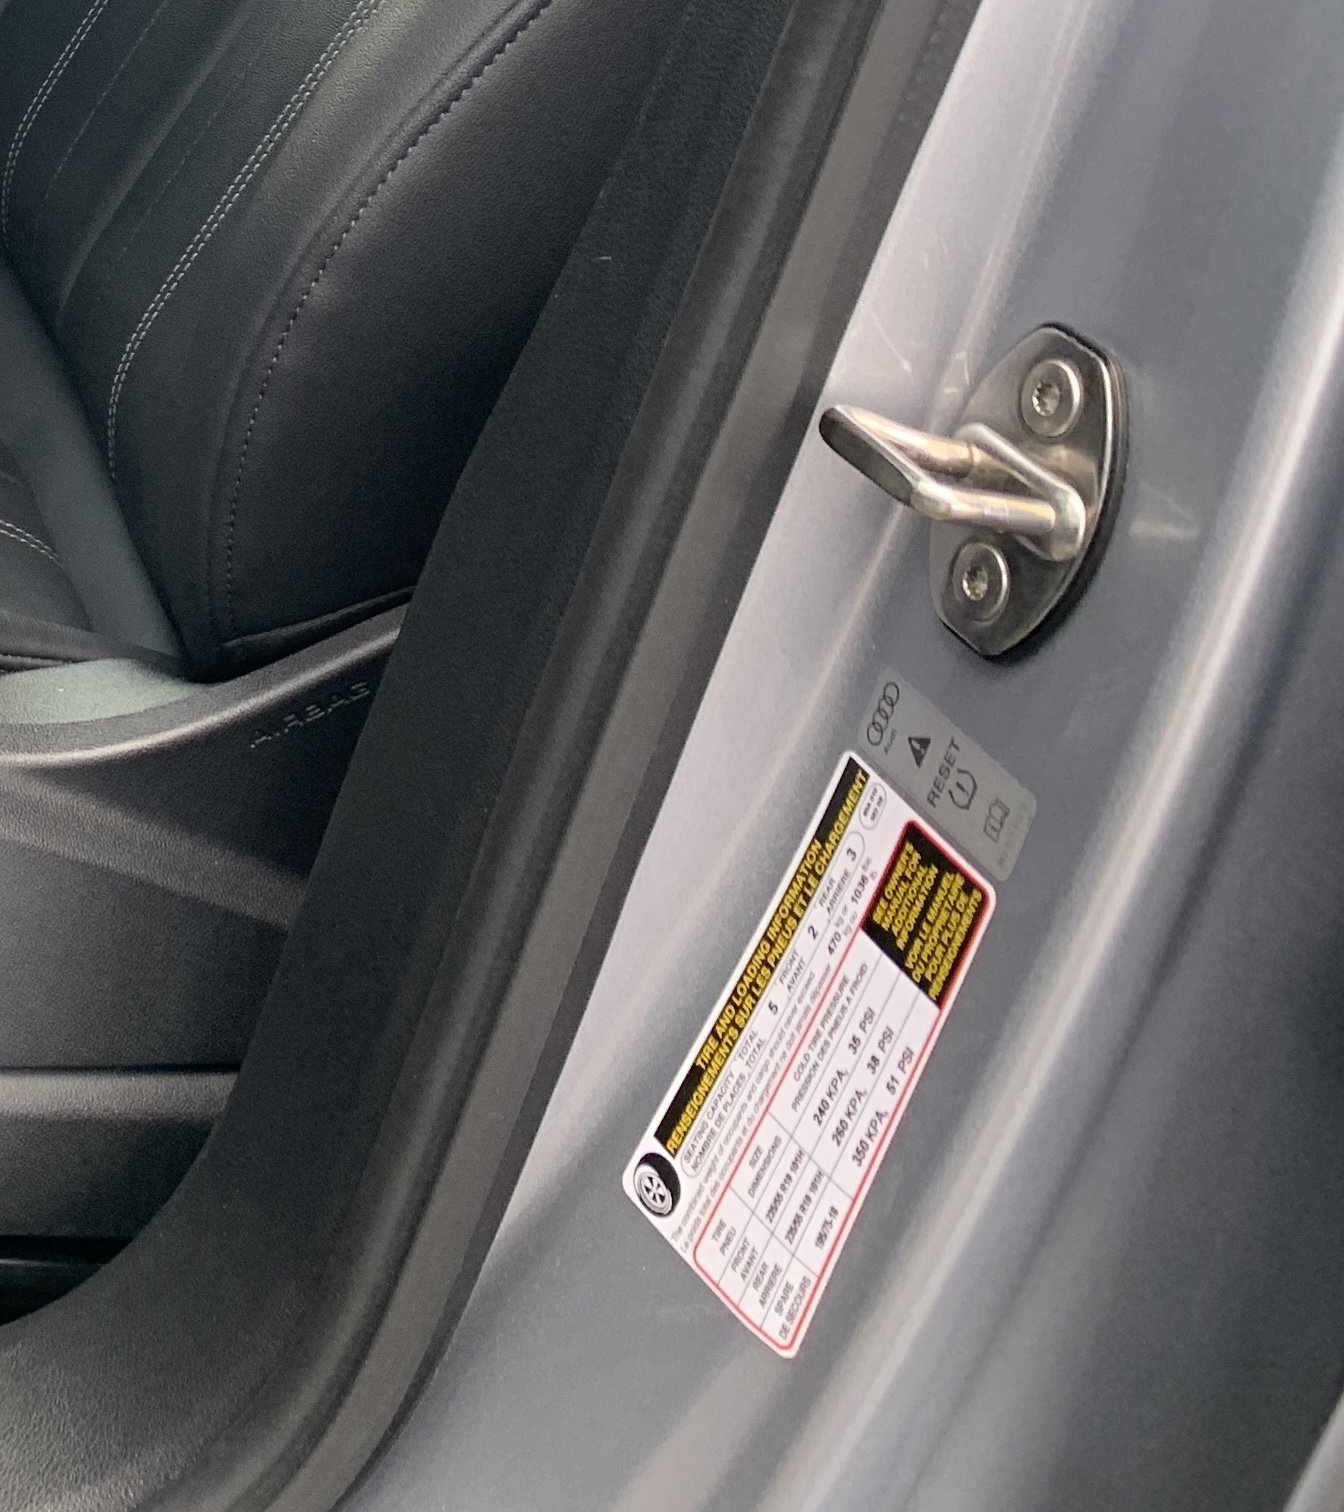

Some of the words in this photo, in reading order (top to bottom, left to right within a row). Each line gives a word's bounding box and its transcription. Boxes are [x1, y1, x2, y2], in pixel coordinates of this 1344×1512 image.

[250, 682, 371, 748] AIRBAG
[926, 737, 961, 808] RESET
[845, 846, 858, 862] 3
[817, 876, 836, 908] REAR
[879, 876, 910, 931] MANUAL
[903, 849, 923, 881] FOR
[889, 860, 929, 937] ADDITIONAL
[894, 862, 940, 951] INFORMATION
[924, 867, 955, 924] MANUEL
[871, 896, 889, 925] SEE
[806, 924, 819, 941] 2
[825, 929, 842, 956] 470
[917, 919, 932, 941] LE
[923, 942, 947, 983] POUR
[939, 908, 961, 946] PLUS
[953, 889, 969, 913] DE
[927, 886, 983, 1002] RENSEIGNEMENTS
[664, 1023, 740, 1156] RENSEIGNEMENTS
[732, 992, 756, 1030] SUR
[749, 963, 772, 998] LES
[765, 913, 799, 969] PNEUS
[791, 893, 810, 919] ET
[802, 872, 820, 897] LE
[813, 768, 868, 877] CHARGEMENT
[695, 1033, 720, 1073] TIRE
[712, 1001, 737, 1040] AND
[730, 937, 771, 1007] LOADING
[764, 837, 824, 942] INFORMATION
[777, 947, 800, 986] FRONT
[903, 936, 924, 971] VOIR
[910, 959, 926, 984] DU
[785, 957, 806, 993] AVANT
[767, 999, 780, 1016] 5
[737, 1026, 758, 1062] TOTAL
[790, 1059, 820, 1113] PRESSION
[815, 1036, 831, 1062] DES
[826, 1001, 849, 1041] PNEUS
[848, 960, 869, 997] FROID
[792, 1050, 811, 1084] COLD
[807, 1026, 824, 1054] TIRE
[818, 973, 850, 1031] PRESSURE
[846, 1032, 862, 1056] 35
[857, 1004, 876, 1035] PSI
[744, 1035, 765, 1071] TOTAL
[865, 1052, 880, 1075] 38
[876, 1024, 895, 1054] PSI
[884, 1072, 900, 1096] 51
[896, 1044, 915, 1075] PSI
[682, 1118, 710, 1165] SEATING
[705, 1069, 735, 1122] CAPACITY
[690, 1126, 717, 1173] NOMBRE
[713, 1110, 726, 1129] DE
[721, 1071, 746, 1114] PLACES
[811, 1096, 831, 1127] 240
[830, 1116, 850, 1148] 260
[747, 1143, 764, 1170] SIZE
[747, 1133, 782, 1200] DIMENSIONS
[850, 1136, 870, 1169] 350
[710, 1217, 727, 1244] TIRE
[718, 1225, 737, 1257] PNEU
[730, 1236, 751, 1273] FRONT
[739, 1245, 759, 1282] AVANT
[751, 1260, 769, 1292] REAR
[773, 1279, 794, 1317] SPARE
[784, 1273, 812, 1326] SECOURS
[778, 1321, 791, 1341] DE
